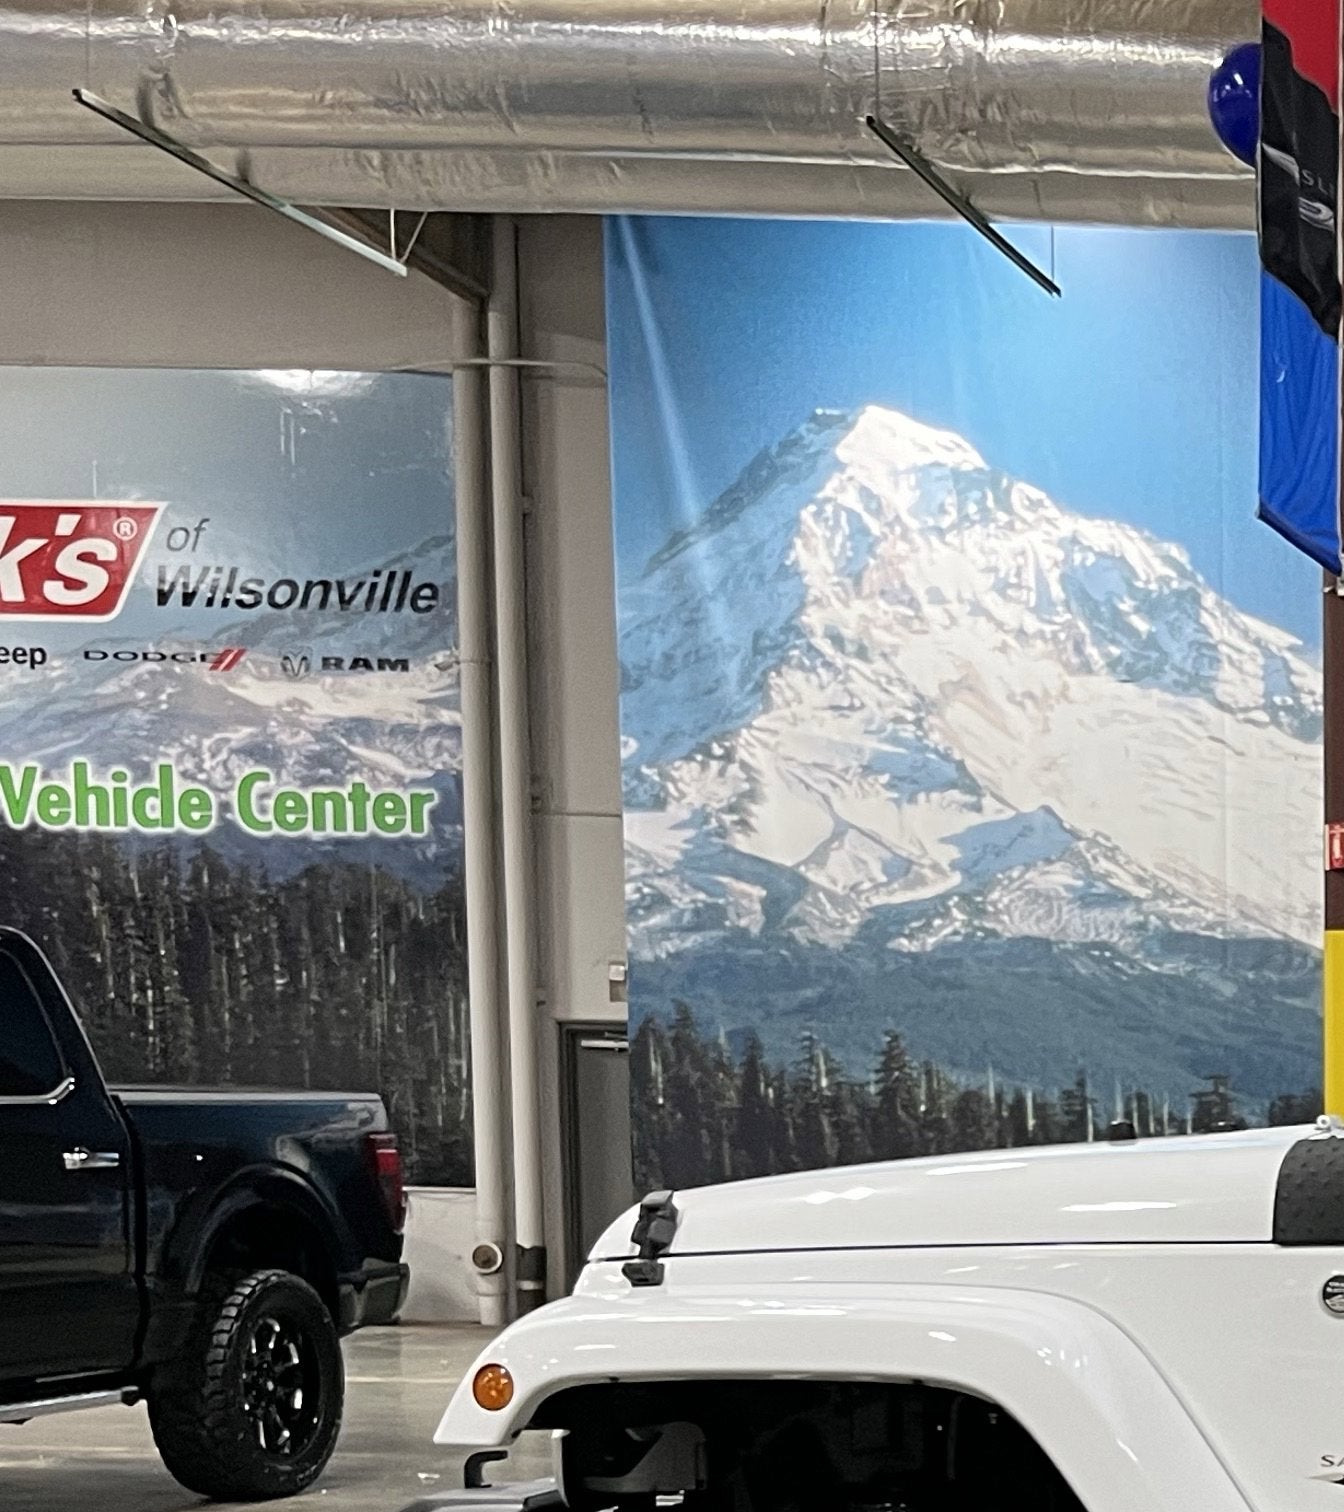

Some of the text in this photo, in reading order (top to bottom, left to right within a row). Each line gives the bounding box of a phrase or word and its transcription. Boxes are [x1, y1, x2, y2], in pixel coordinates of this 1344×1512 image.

[166, 518, 210, 552] of
[156, 564, 440, 614] Wilsonville
[321, 656, 410, 673] RAM
[0, 761, 435, 834] Vehicle Center
